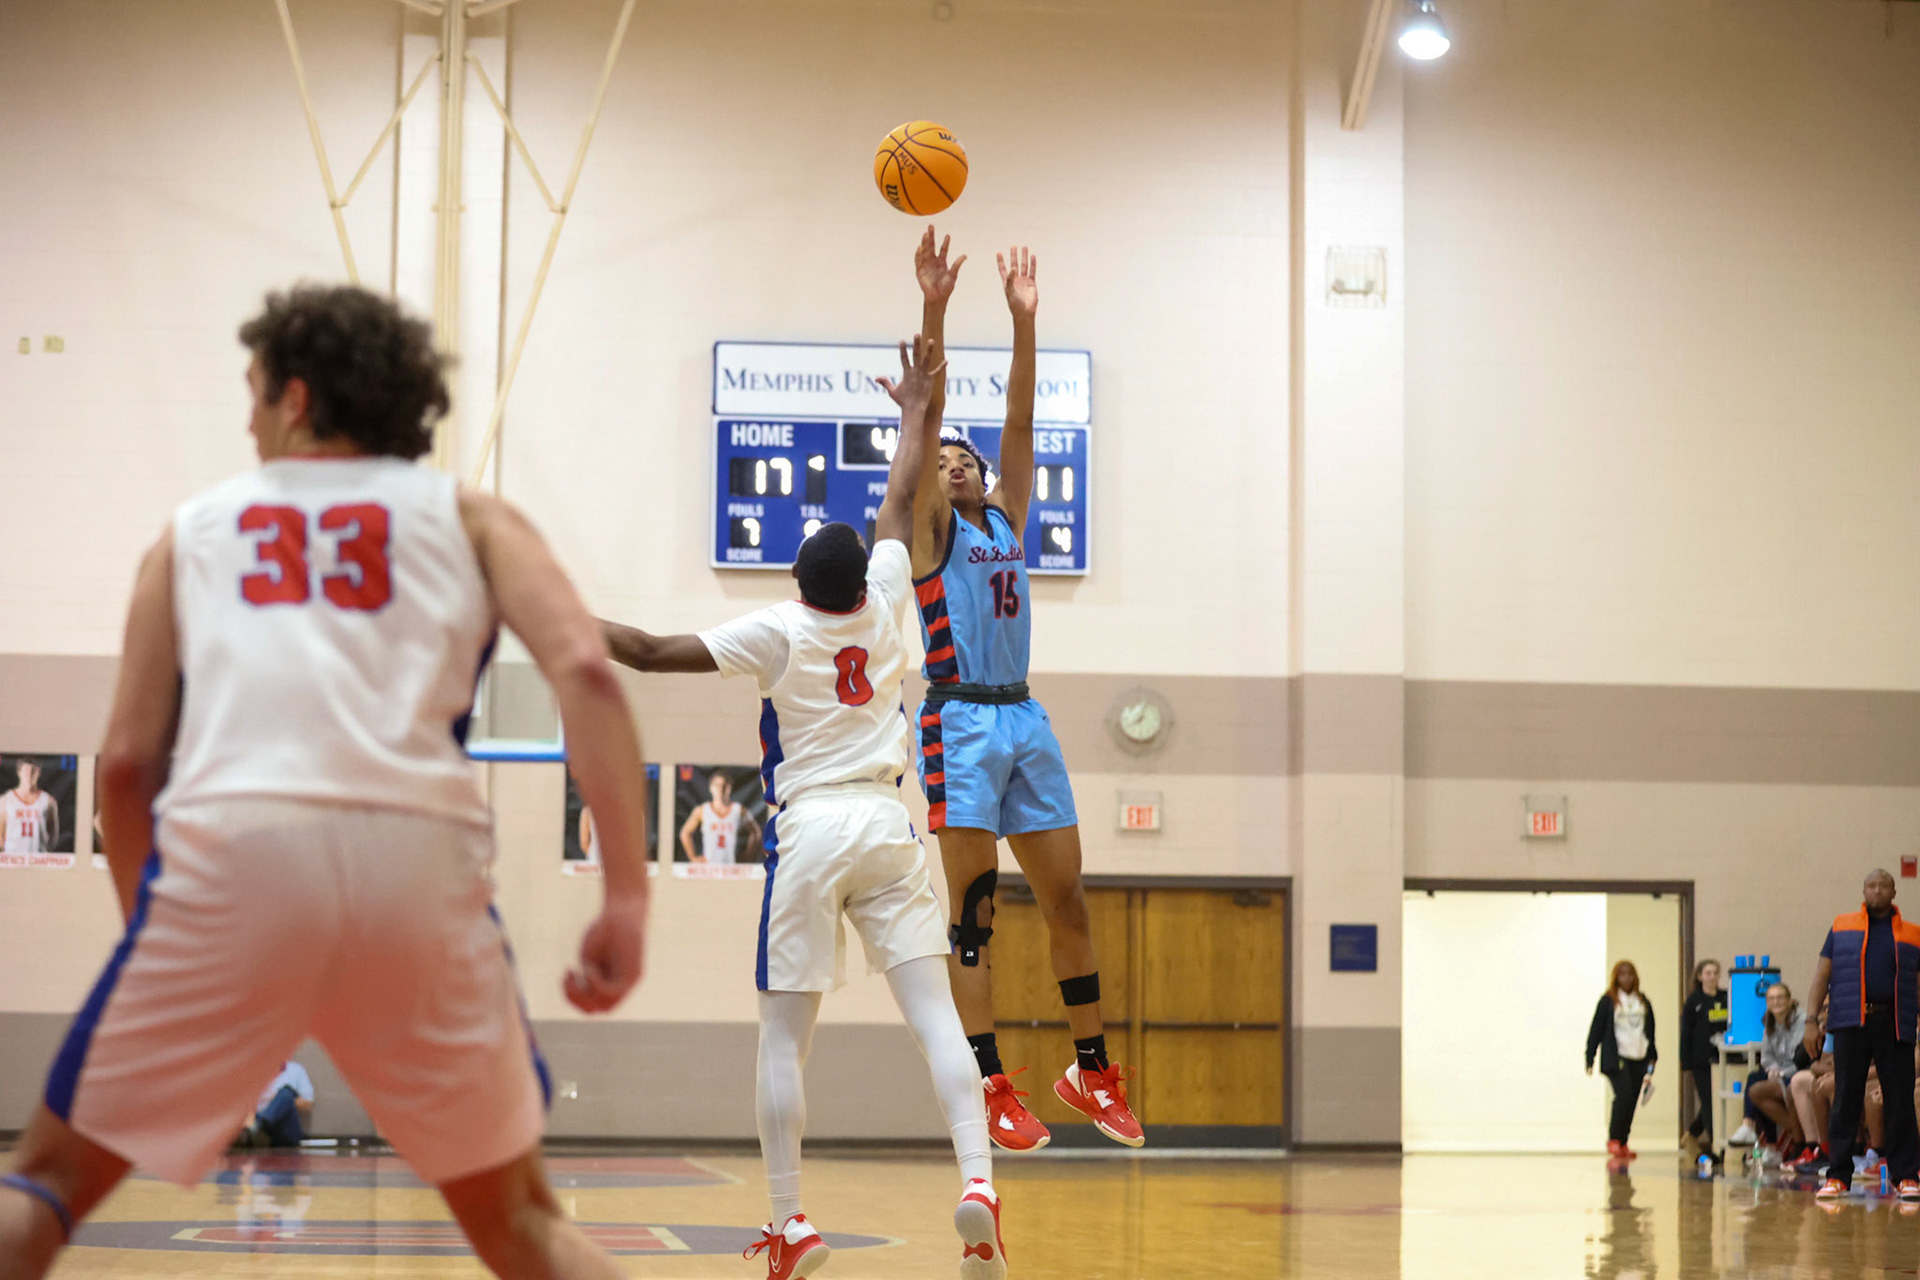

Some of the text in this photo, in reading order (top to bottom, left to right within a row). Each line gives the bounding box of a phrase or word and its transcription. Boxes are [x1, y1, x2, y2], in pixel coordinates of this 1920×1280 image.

[723, 368, 834, 392] MEMPHIS
[988, 374, 1078, 398] SOOL
[731, 424, 794, 446] HOME
[1033, 431, 1077, 454] EST
[755, 457, 793, 495] 17
[727, 503, 764, 518] FOULS
[1039, 510, 1075, 525] FOULS
[238, 502, 394, 612] 33
[726, 549, 763, 562] SCORE
[1039, 555, 1075, 568] SCORE
[989, 570, 1021, 620] 15
[833, 645, 874, 707] 0
[1127, 805, 1154, 829] EXIT
[1533, 811, 1558, 836] EXIT
